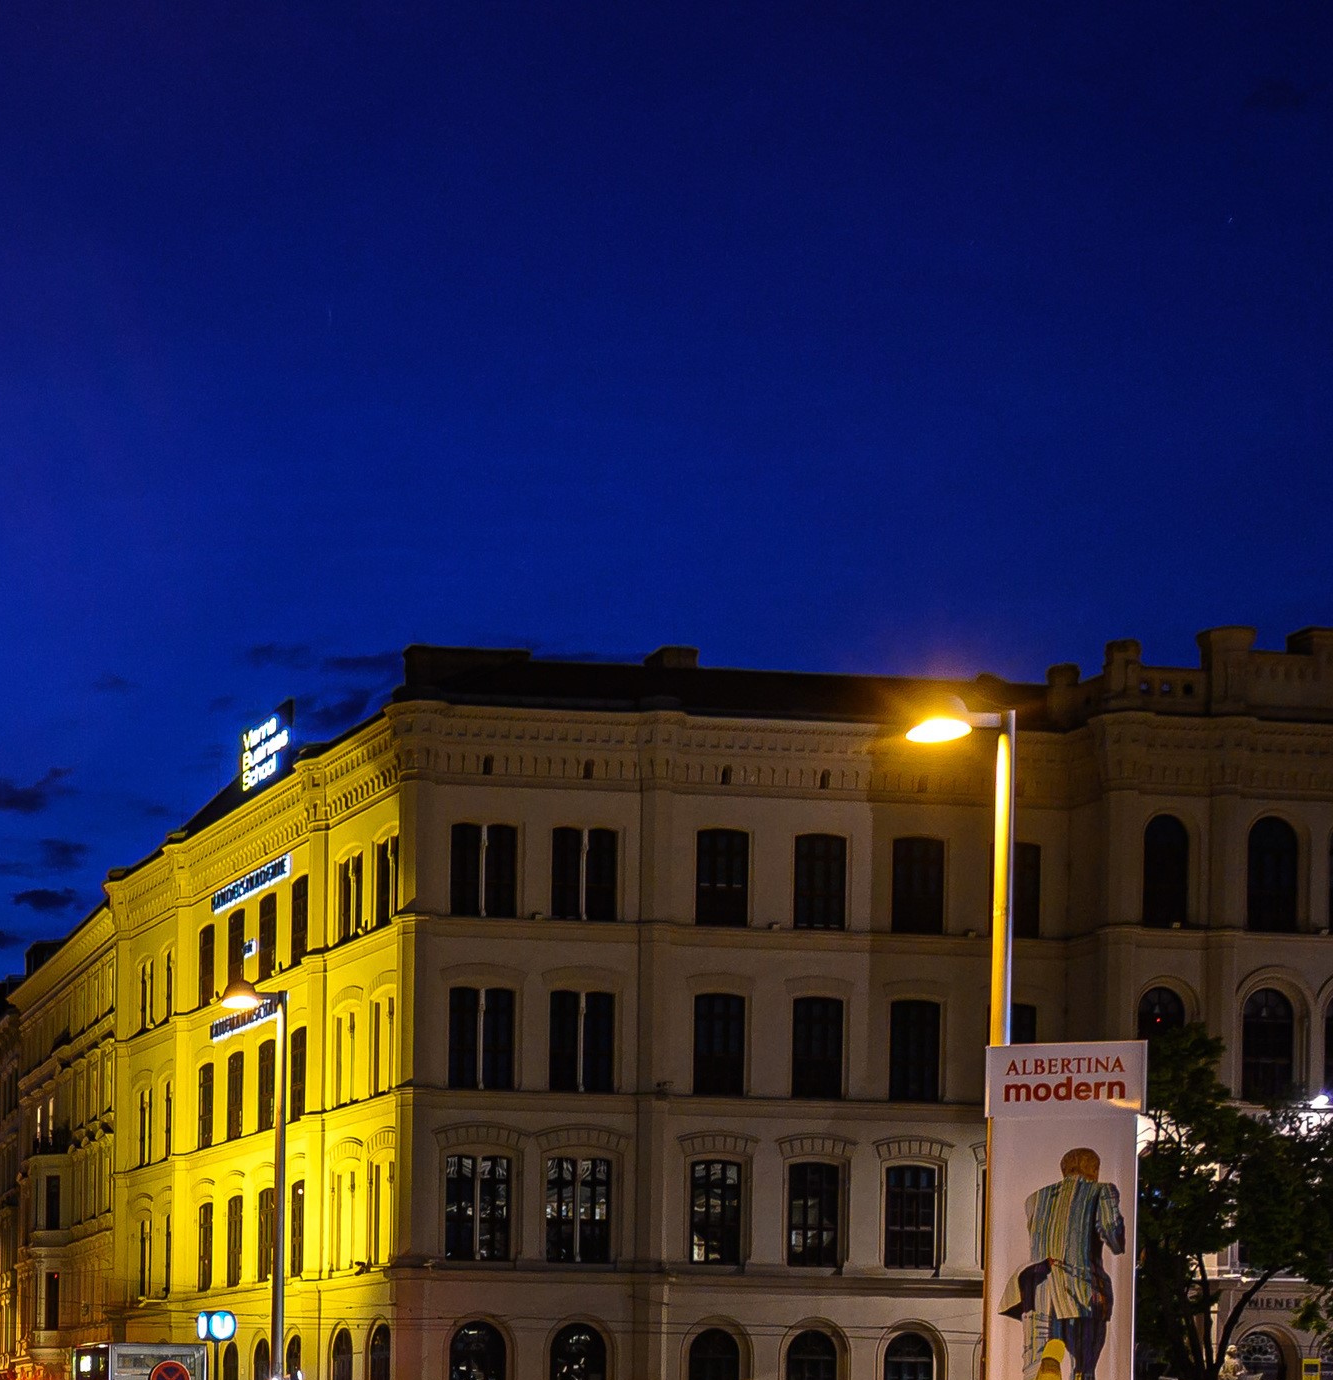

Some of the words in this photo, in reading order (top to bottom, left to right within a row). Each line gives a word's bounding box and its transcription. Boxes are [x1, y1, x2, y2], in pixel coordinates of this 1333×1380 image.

[242, 729, 289, 772] Business
[243, 717, 277, 751] Vienna
[242, 752, 277, 791] School
[1005, 1055, 1126, 1076] ALBERTINA
[1003, 1076, 1126, 1103] modern
